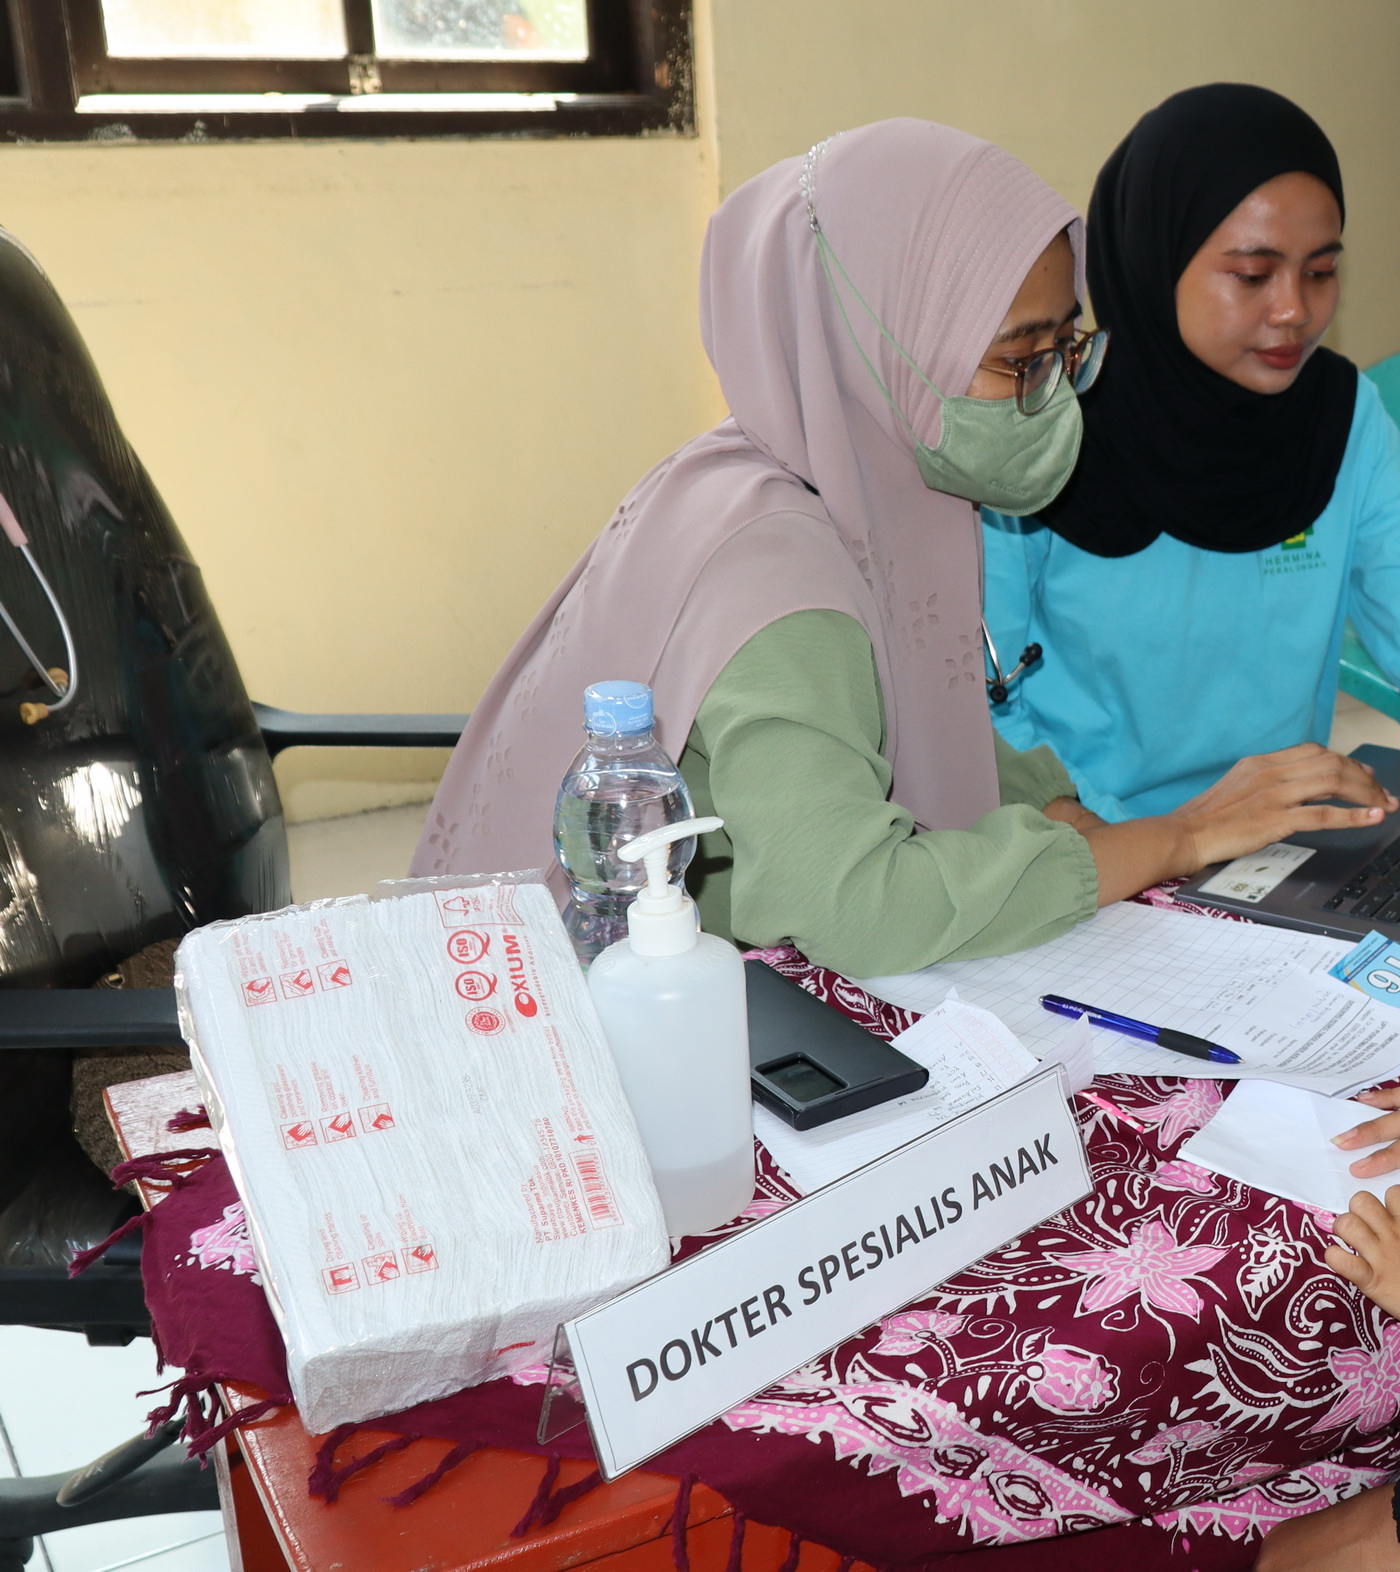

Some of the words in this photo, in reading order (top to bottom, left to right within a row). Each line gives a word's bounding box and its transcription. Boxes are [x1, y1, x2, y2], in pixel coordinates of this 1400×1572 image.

[1265, 551, 1321, 566] HERMINA
[455, 938, 469, 956] ISO
[523, 935, 535, 965] Additive
[463, 978, 477, 994] ISO
[503, 935, 538, 1017] OXIUM
[543, 1116, 563, 1161] 10107710780
[558, 1162, 569, 1177] PKD
[563, 1178, 573, 1187] RI
[522, 1193, 543, 1244] Manufactured
[532, 1192, 549, 1226] Suparma
[545, 1203, 561, 1240] Surabaya
[561, 1200, 577, 1236] Customer
[568, 1189, 586, 1233] KEMENKES
[626, 1284, 792, 1402] DOKTER
[797, 1187, 963, 1306] SPESIALIS
[972, 1133, 1059, 1211] ANAK
